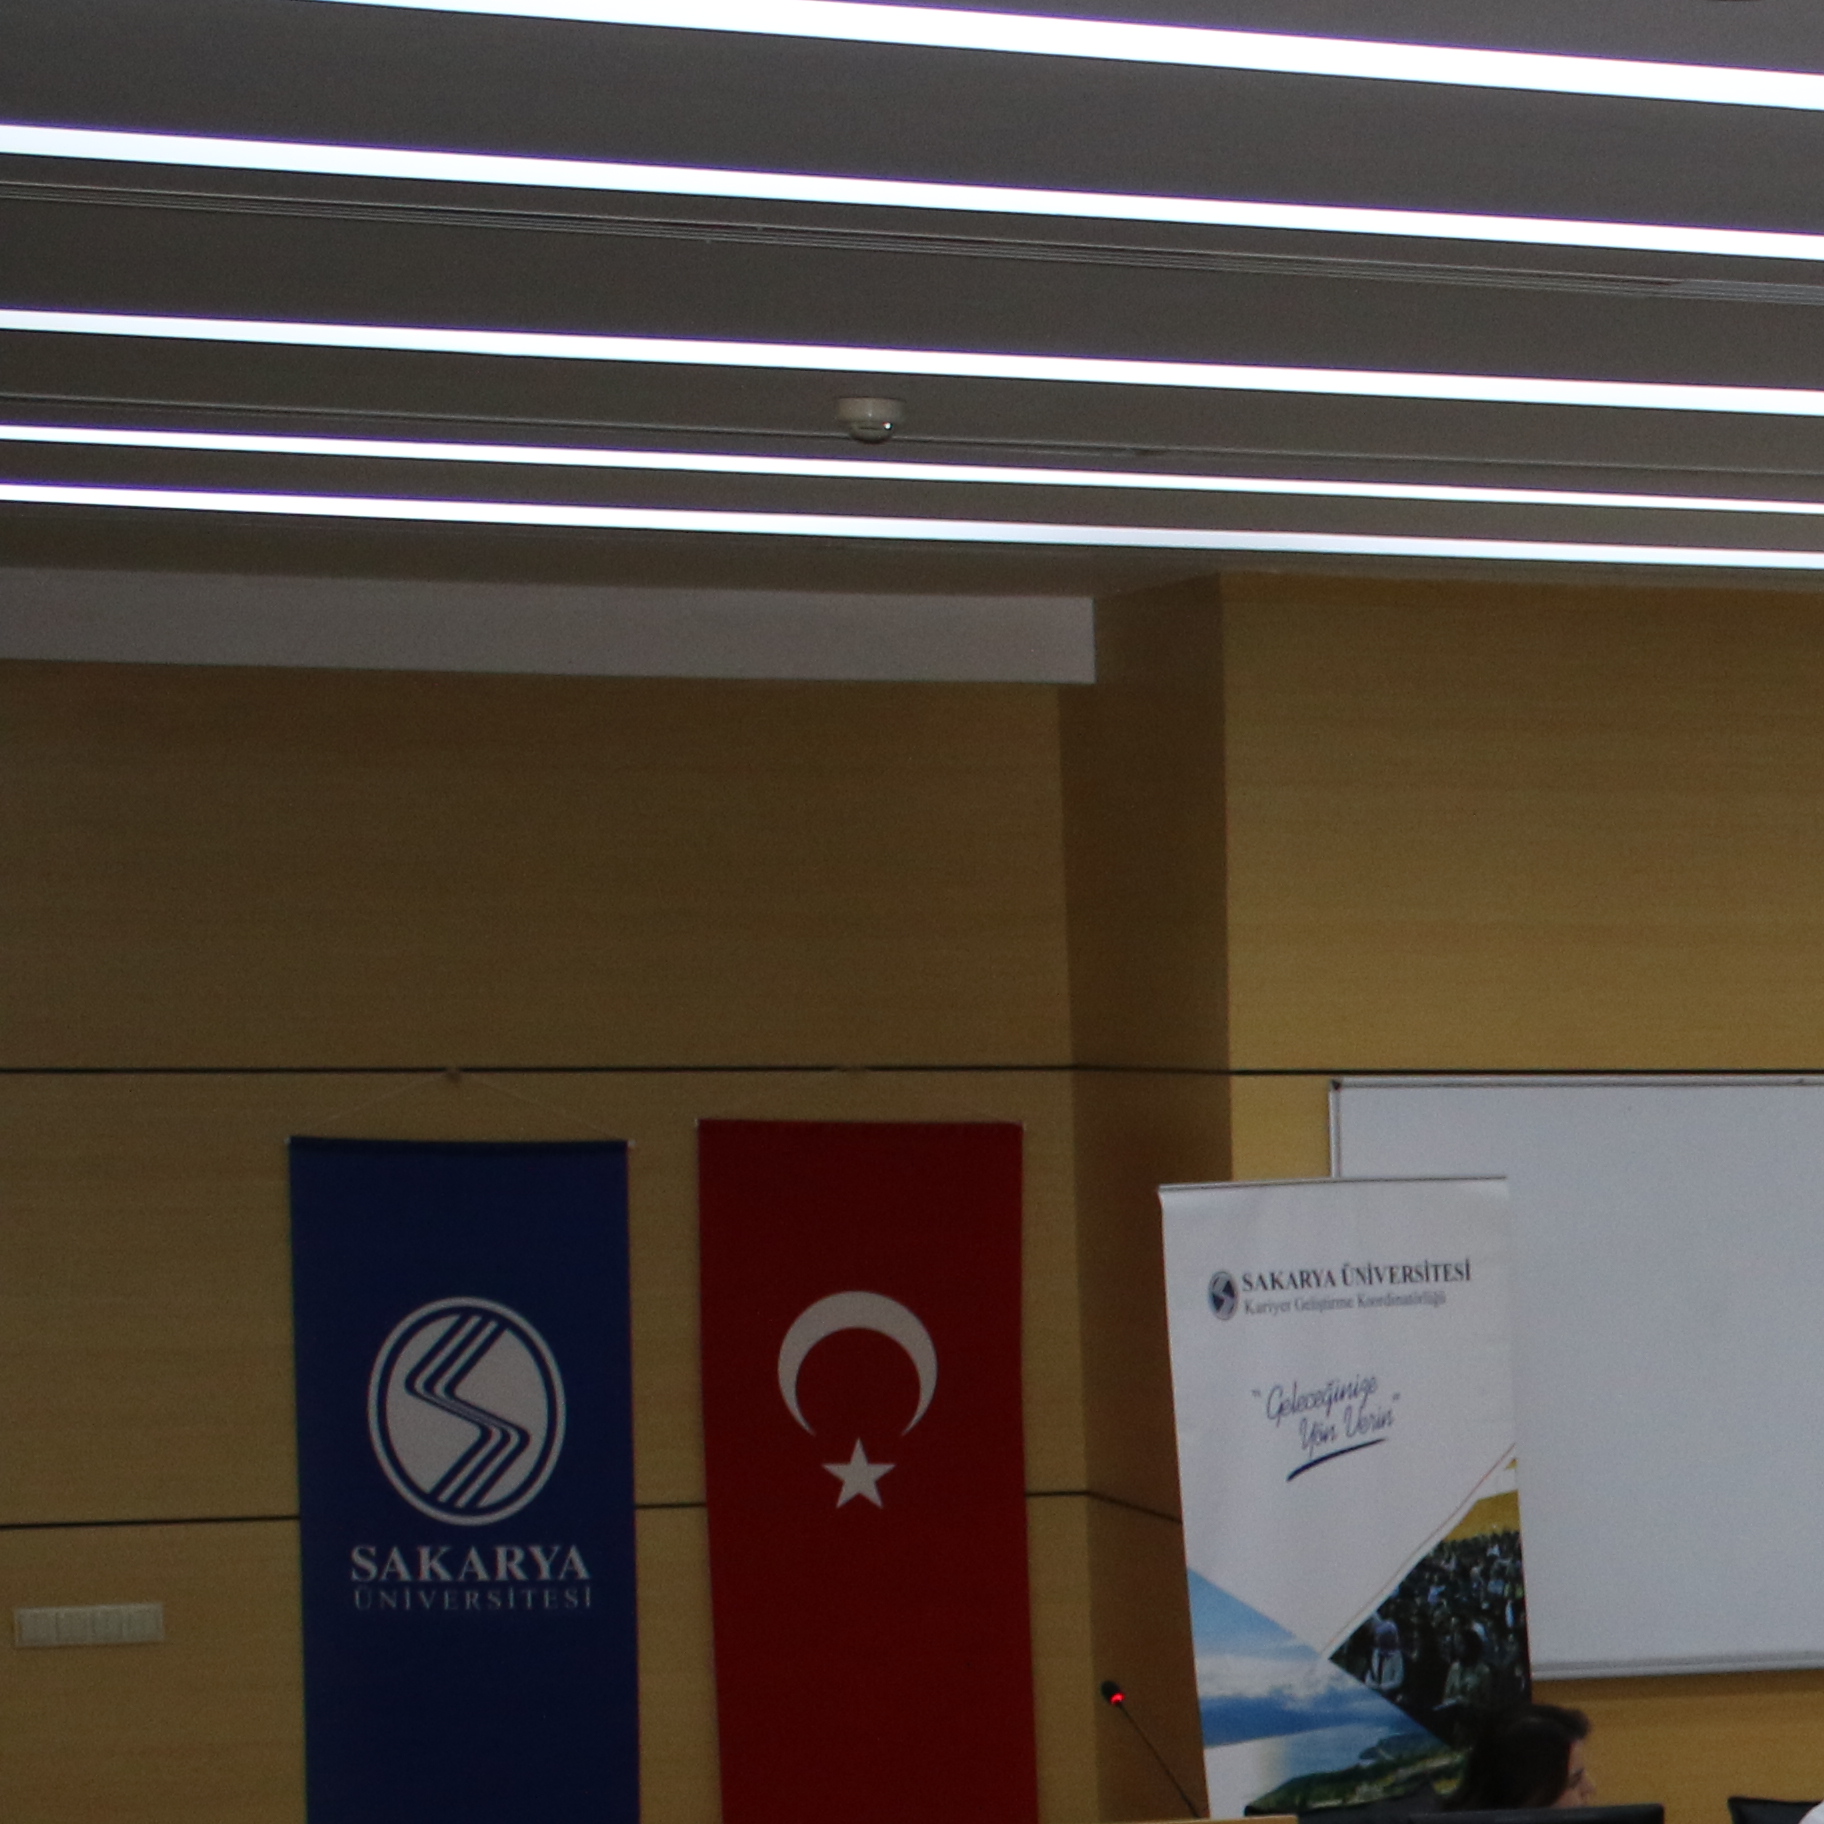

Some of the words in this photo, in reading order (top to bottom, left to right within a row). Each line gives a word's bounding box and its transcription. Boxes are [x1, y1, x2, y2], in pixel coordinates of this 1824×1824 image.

[1242, 1267, 1339, 1293] SAKARYA
[1340, 1257, 1472, 1288] ÜNİVERSİTESİ
[1244, 1299, 1292, 1317] Kariyer
[1293, 1297, 1355, 1314] Geliştirme
[1356, 1290, 1447, 1310] Koordinatörlüğü
[1299, 1417, 1338, 1462] Yön
[350, 1544, 593, 1583] SAKARYA
[353, 1584, 593, 1612] ÜNİVERSİTESİ
